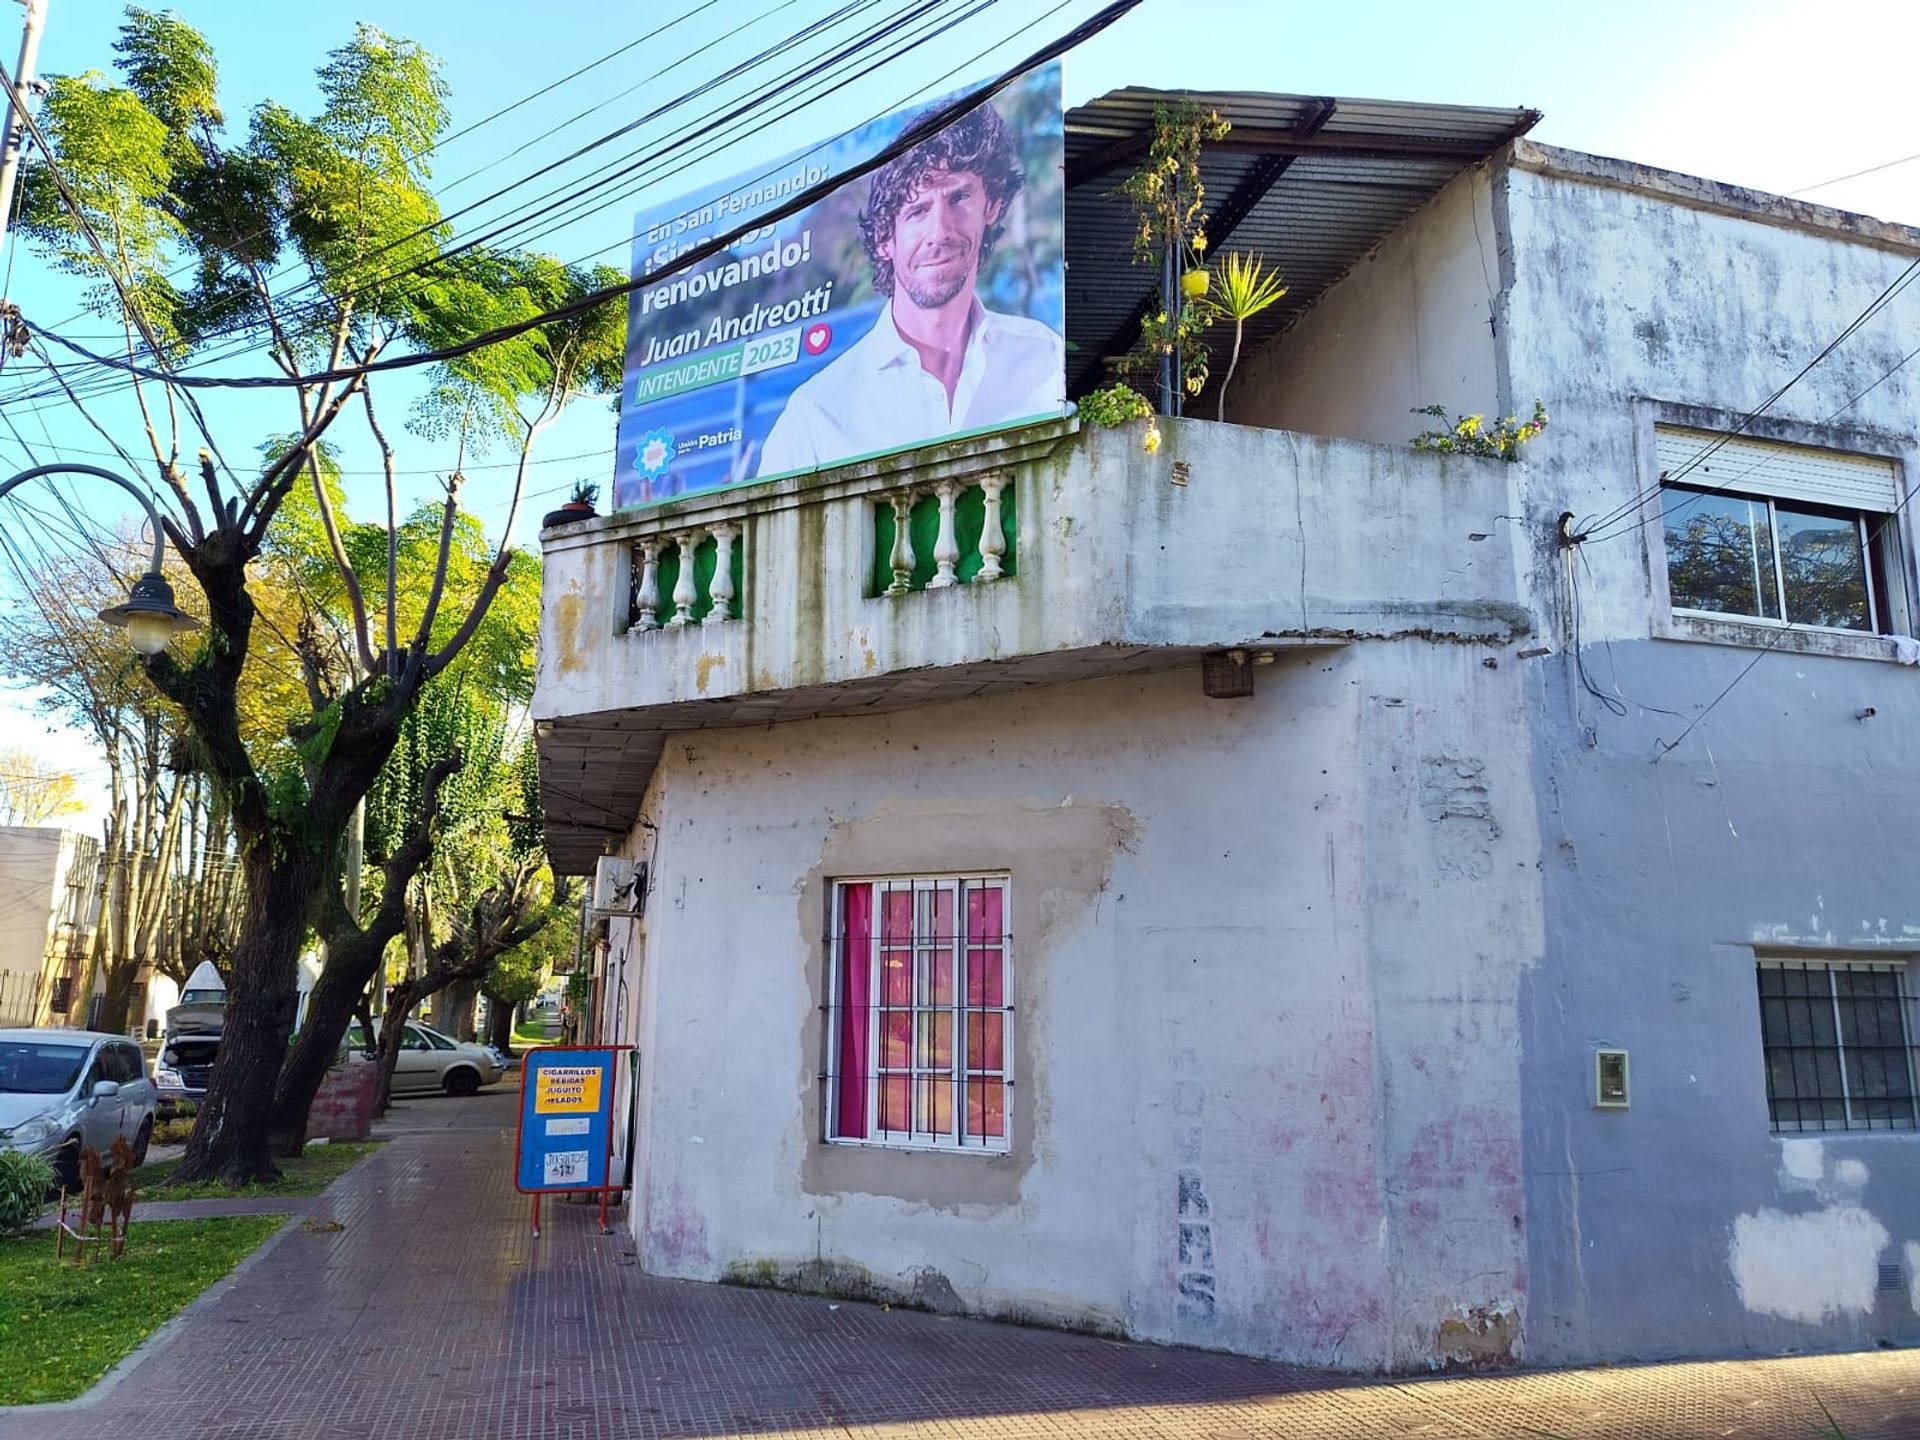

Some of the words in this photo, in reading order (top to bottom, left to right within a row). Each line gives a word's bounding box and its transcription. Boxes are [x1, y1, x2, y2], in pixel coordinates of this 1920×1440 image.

[646, 221, 672, 245] En
[674, 206, 715, 235] San
[641, 230, 812, 315] renovando!
[640, 336, 701, 367] Juan
[703, 280, 833, 347] Andreotti
[638, 351, 741, 399] INTENDENTE
[745, 336, 795, 368] 2023
[698, 427, 742, 449] Patria
